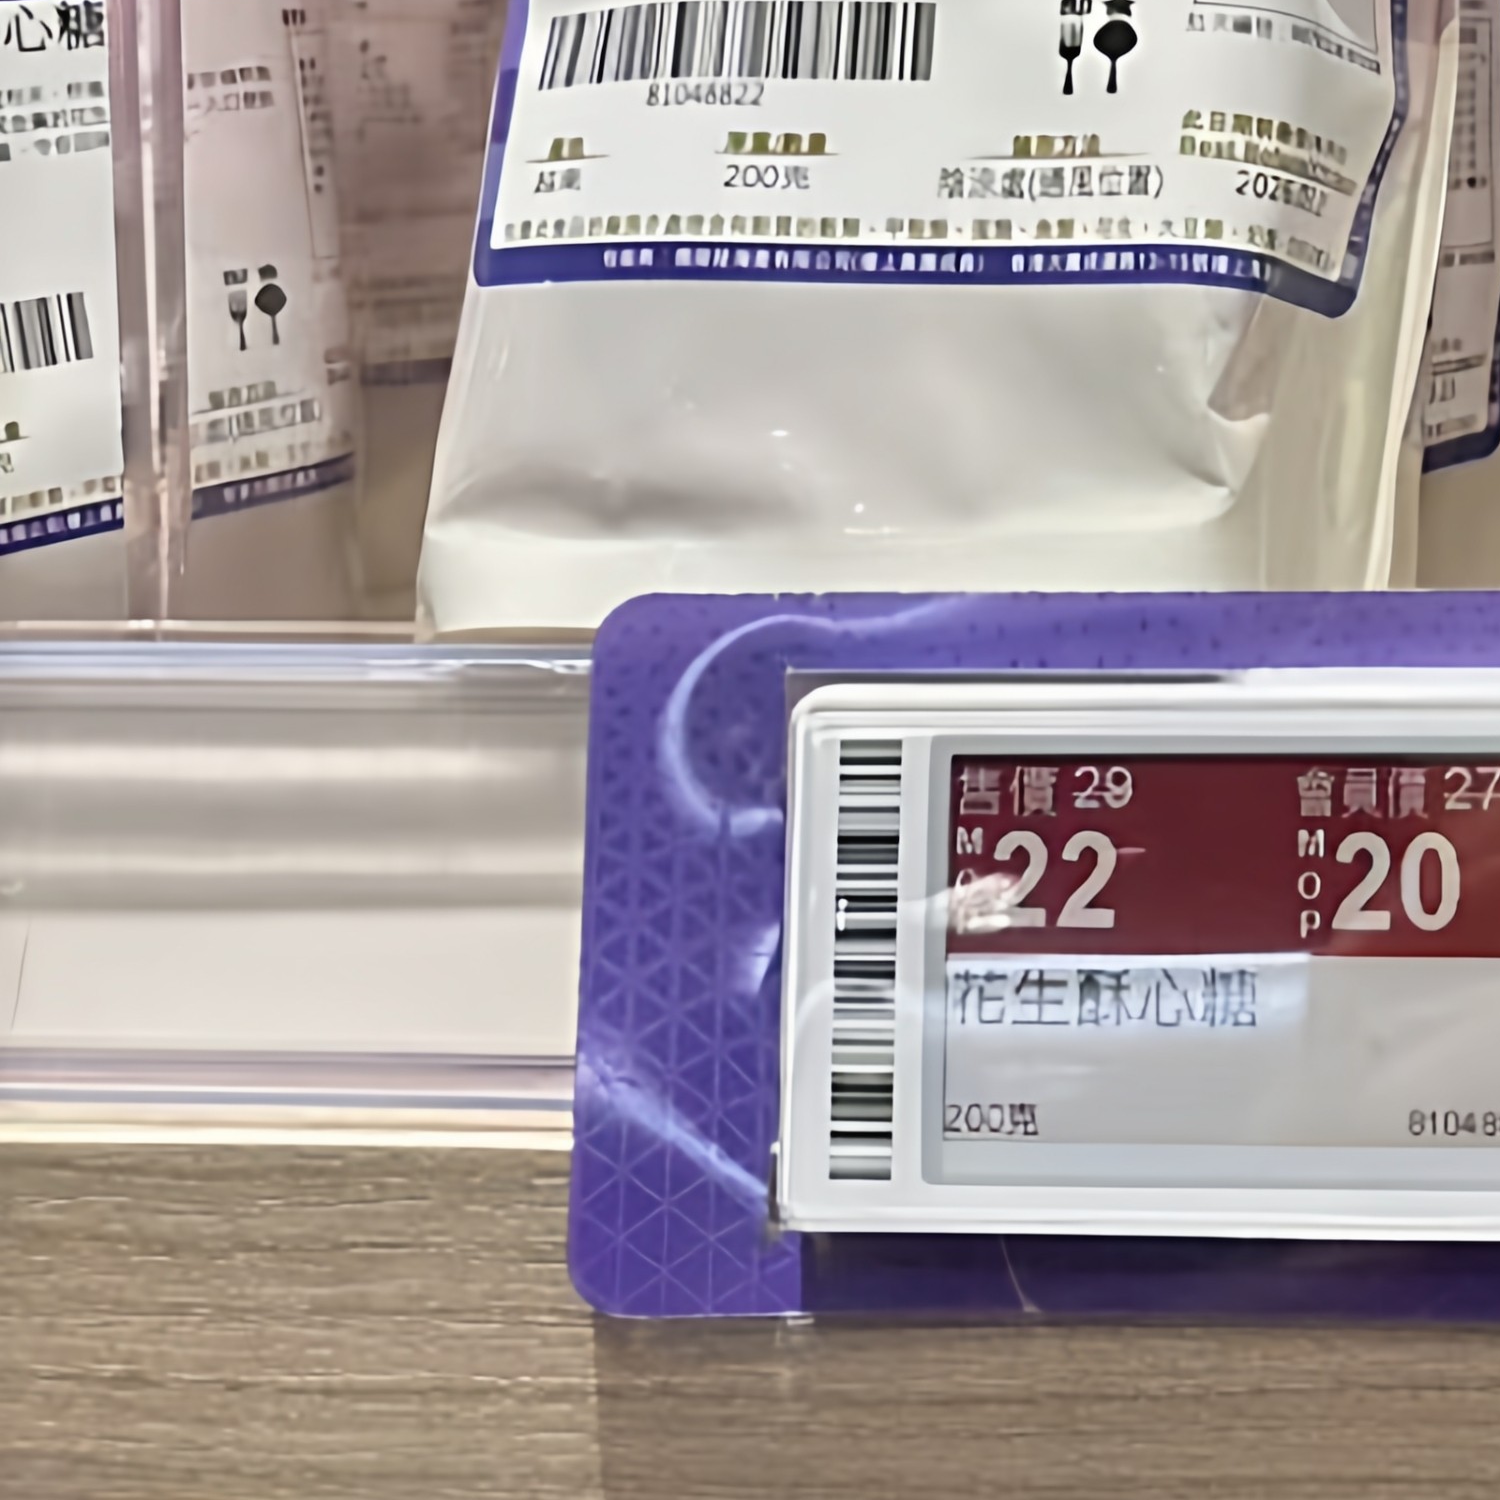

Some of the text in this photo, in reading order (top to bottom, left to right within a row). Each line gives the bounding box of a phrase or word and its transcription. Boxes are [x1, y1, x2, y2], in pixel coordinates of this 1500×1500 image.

[957, 765, 1134, 818] 售價 29
[1296, 765, 1431, 819] 會員價
[992, 829, 1118, 929] 22
[1297, 828, 1461, 939] MOP 20
[952, 967, 1258, 1028] 花生酥心糖
